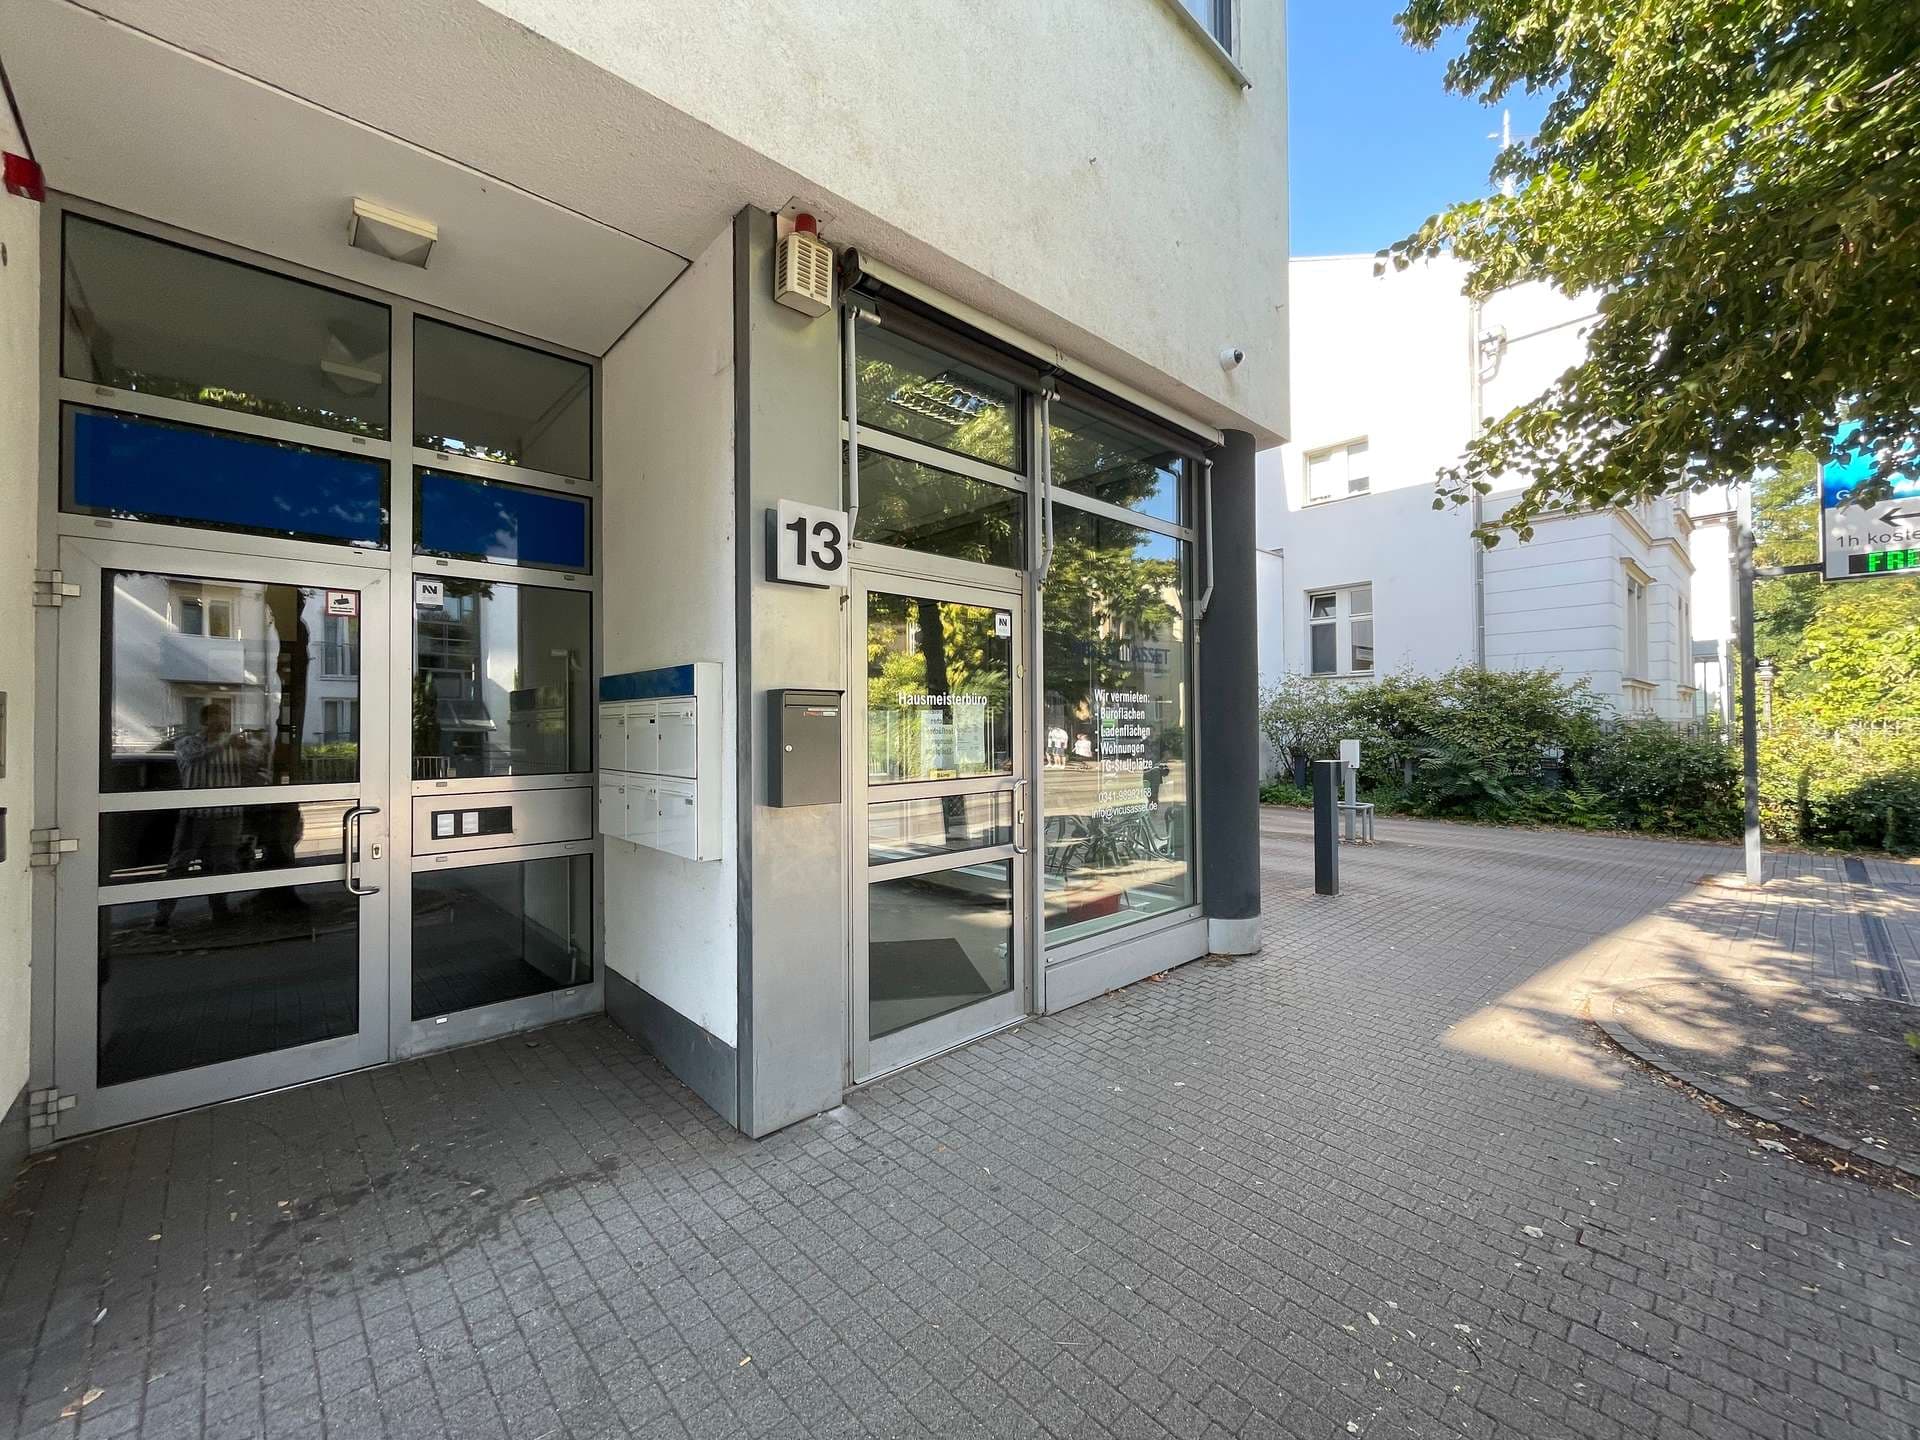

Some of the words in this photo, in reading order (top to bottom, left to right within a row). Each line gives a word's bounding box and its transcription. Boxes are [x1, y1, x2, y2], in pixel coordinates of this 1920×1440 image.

[786, 516, 843, 571] 13
[1836, 535, 1859, 548] 1h
[898, 692, 988, 706] Hausmeisterbüro
[1094, 689, 1109, 702] Wir
[1110, 690, 1150, 703] vermieten:
[1100, 707, 1145, 720] Büroflächen
[1100, 724, 1151, 738] Ladenflächen
[1100, 741, 1145, 756] Wohnungen
